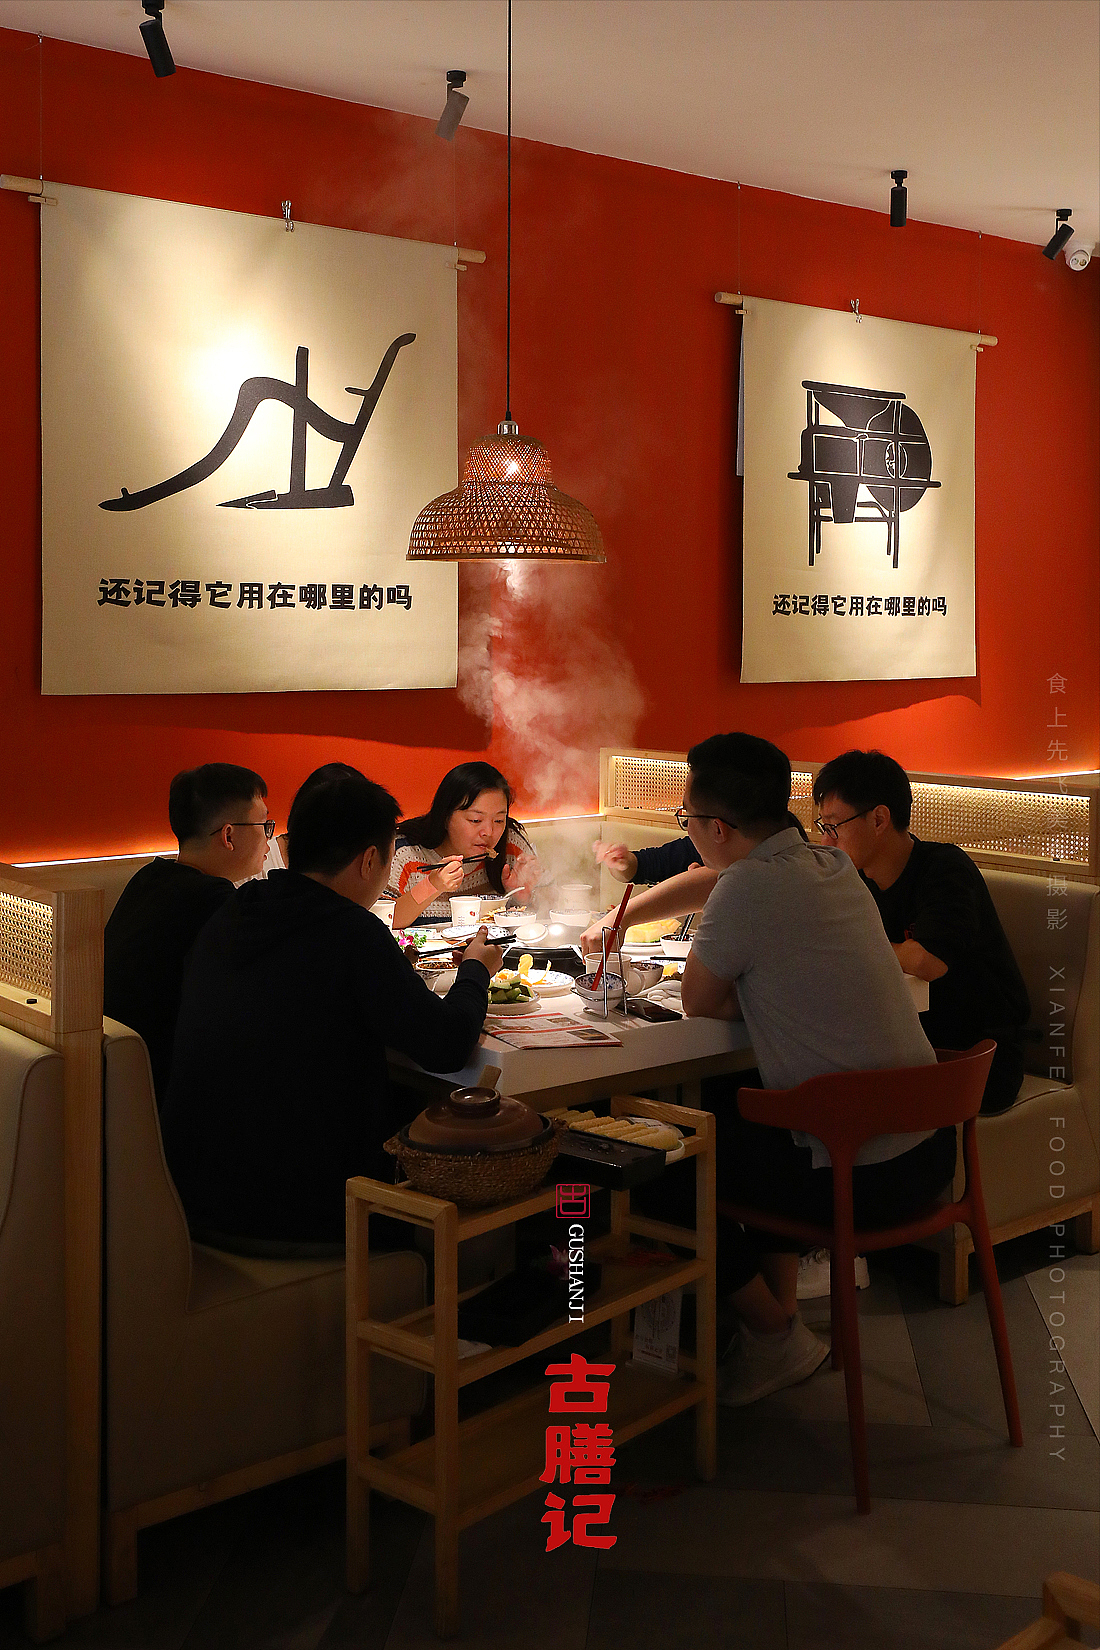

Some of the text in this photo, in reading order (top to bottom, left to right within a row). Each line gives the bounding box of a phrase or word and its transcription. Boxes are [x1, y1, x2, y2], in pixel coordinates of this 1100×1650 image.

[97, 578, 413, 611] 还记得它用在哪里的吗
[772, 594, 947, 617] 还记得它用在哪里的吗
